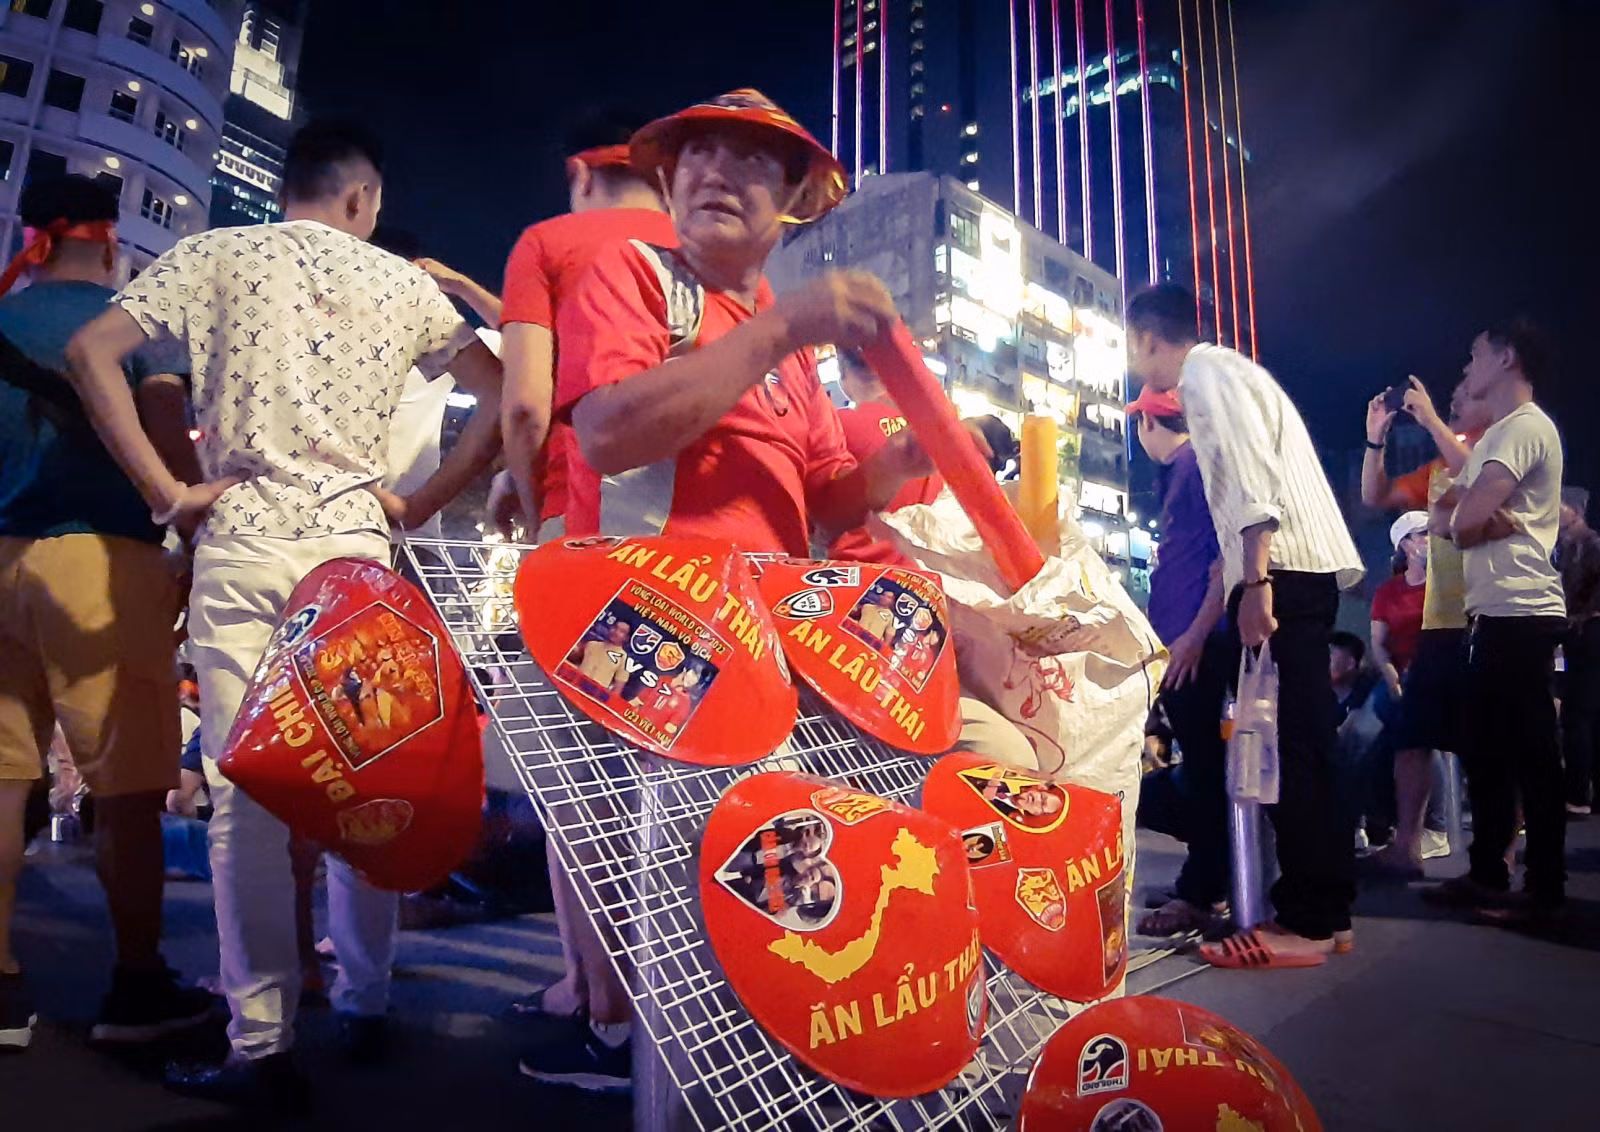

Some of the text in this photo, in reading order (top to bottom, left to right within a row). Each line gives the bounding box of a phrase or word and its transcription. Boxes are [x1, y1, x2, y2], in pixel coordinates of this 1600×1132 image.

[607, 543, 765, 661] ĂN LẨU THÁI
[668, 604, 695, 630] WORLD
[787, 617, 832, 653] ĂN
[828, 643, 881, 693] LẨU
[879, 680, 926, 742] THÁI
[1064, 852, 1101, 893] ĂN
[809, 1001, 863, 1049] ĂN
[872, 962, 937, 1028] LẨU
[1137, 1047, 1227, 1076] THÁI
